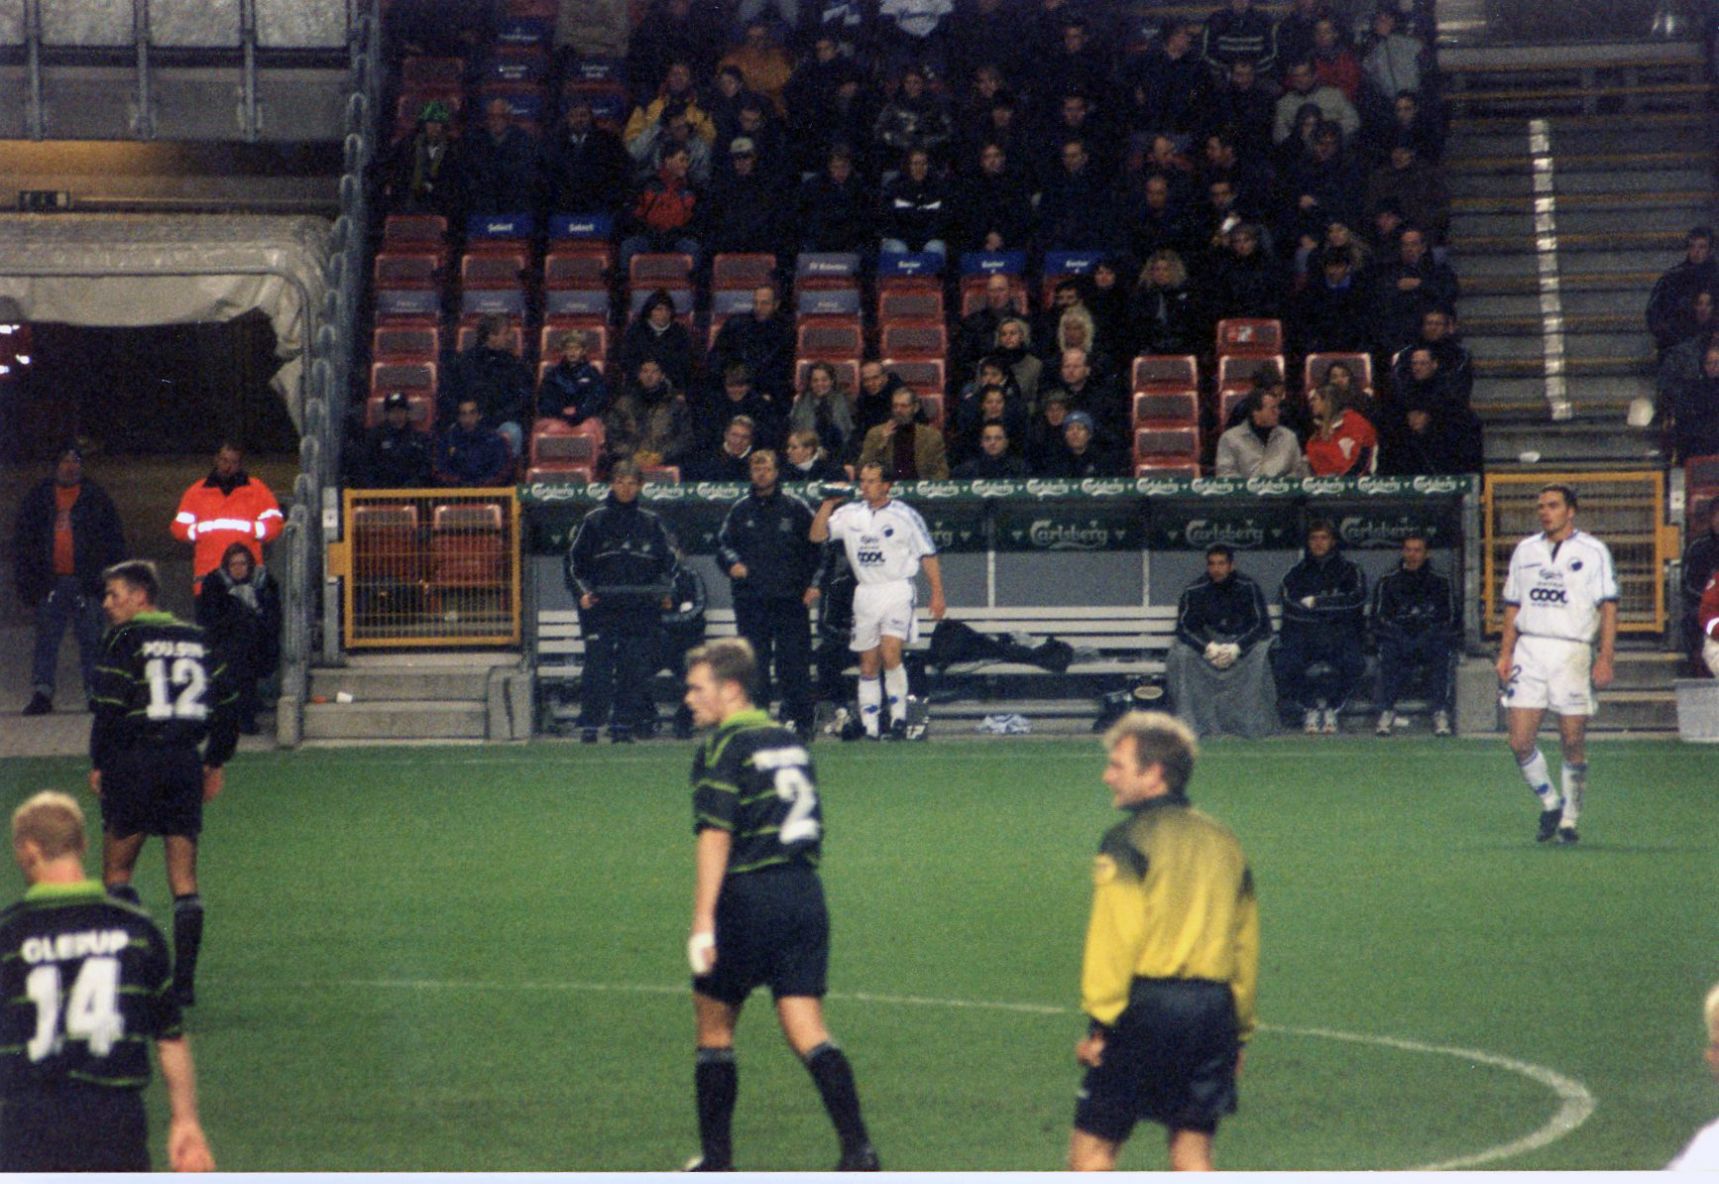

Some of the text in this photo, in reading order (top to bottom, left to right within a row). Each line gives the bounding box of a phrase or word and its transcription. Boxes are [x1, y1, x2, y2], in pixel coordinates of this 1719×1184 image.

[1030, 519, 1109, 549] Carlsberg
[1185, 519, 1264, 549] Carlsberg
[144, 658, 207, 720] 12
[773, 766, 821, 846] 2
[26, 956, 125, 1061] 14
